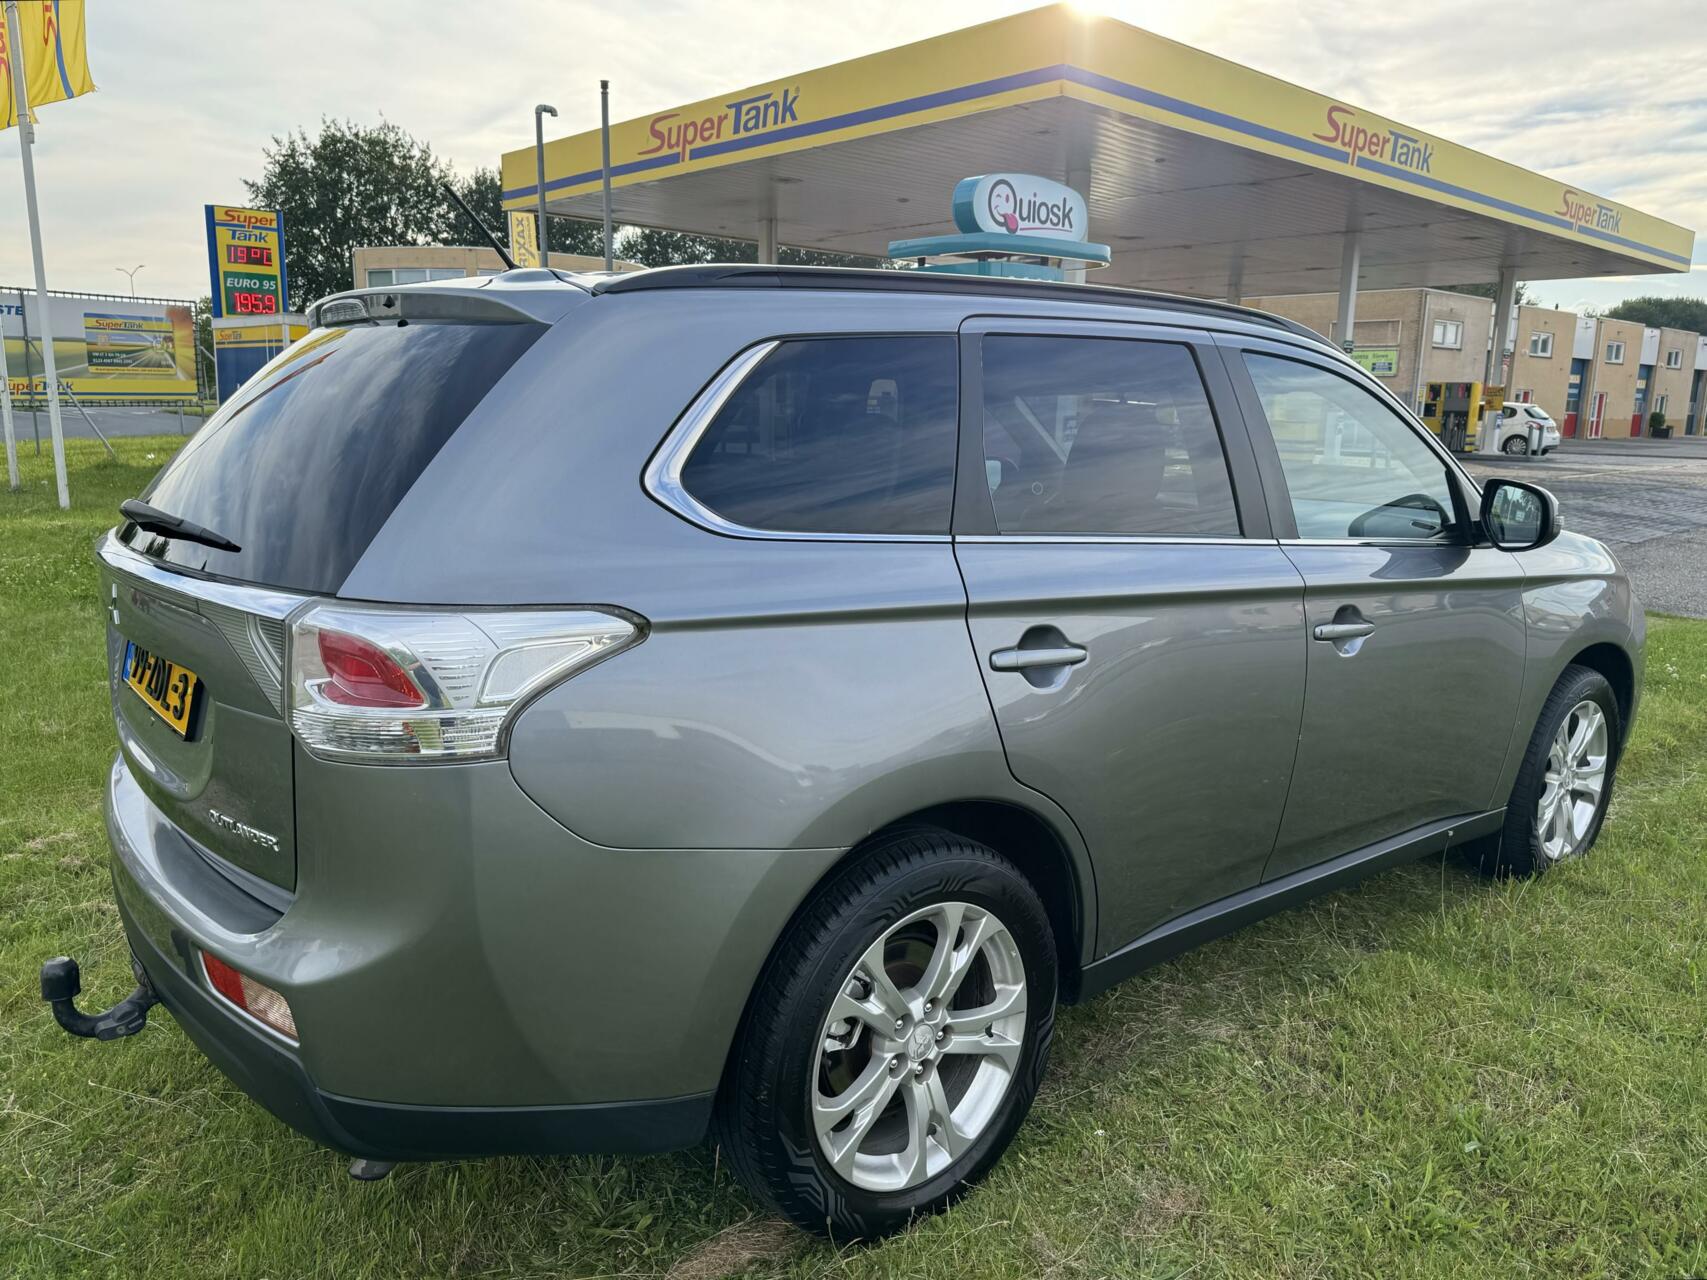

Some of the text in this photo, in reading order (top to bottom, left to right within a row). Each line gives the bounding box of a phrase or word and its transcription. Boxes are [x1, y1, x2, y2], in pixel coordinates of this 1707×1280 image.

[637, 89, 799, 162] SuperTank
[1312, 105, 1433, 173] SuperTank
[216, 209, 276, 229] Super
[987, 178, 1073, 233] Quiosk
[1554, 189, 1621, 233] SuperTank
[226, 228, 268, 243] Tank
[226, 278, 276, 290] EURO 95
